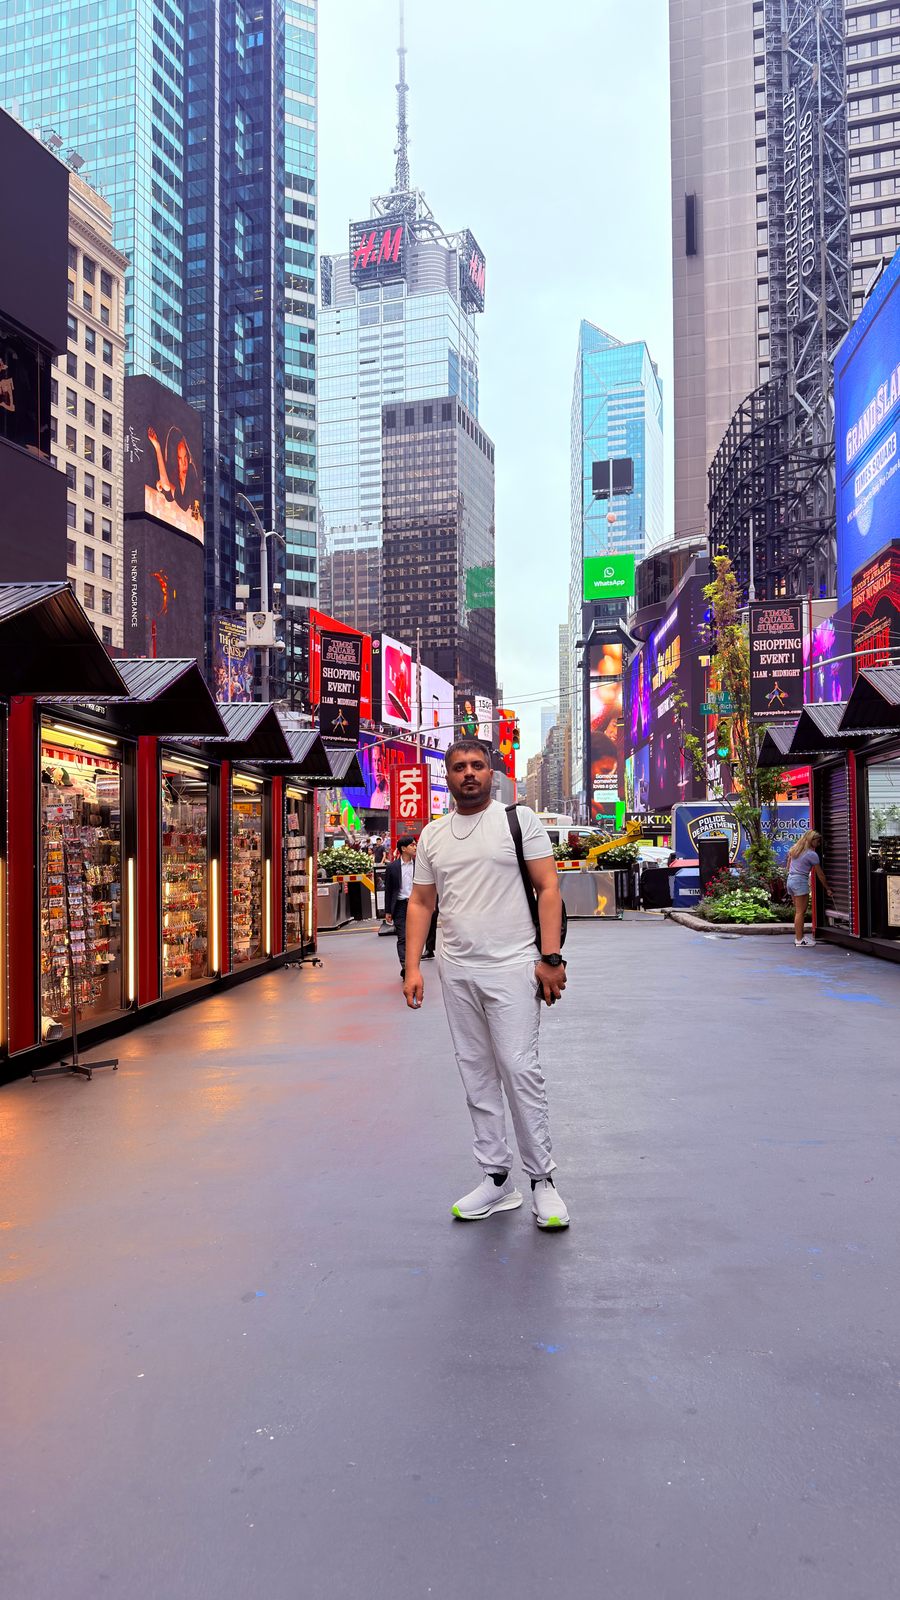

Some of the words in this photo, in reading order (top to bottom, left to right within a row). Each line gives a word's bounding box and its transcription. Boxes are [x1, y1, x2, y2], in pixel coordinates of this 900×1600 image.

[783, 90, 797, 174] EAGLE
[800, 110, 816, 276] OUTFITTERS
[353, 226, 403, 270] H&M
[784, 177, 799, 317] AMERICAN
[469, 250, 485, 297] H&M
[847, 398, 877, 463] GRAND
[855, 465, 872, 495] TIMES
[872, 435, 896, 476] SQUARE
[594, 579, 625, 588] WhatsApp
[759, 615, 794, 624] SQUARE
[763, 609, 790, 618] TIMES
[757, 623, 796, 632] SUMMER
[327, 645, 356, 655] SQUARE
[330, 640, 353, 649] TIMES
[753, 638, 802, 651] SHOPPING
[325, 652, 357, 663] SUMMER
[760, 653, 790, 666] EVENT
[322, 667, 360, 681] SHOPPING
[752, 670, 768, 679] 11AM
[772, 669, 800, 678] MIDNIGHT
[327, 681, 351, 693] EVENT
[321, 696, 334, 704] 11AM
[337, 698, 358, 707] MIDNIGHT
[400, 767, 422, 818] tkts
[699, 815, 726, 827] POLICE
[692, 821, 736, 838] DEPARTMENT
